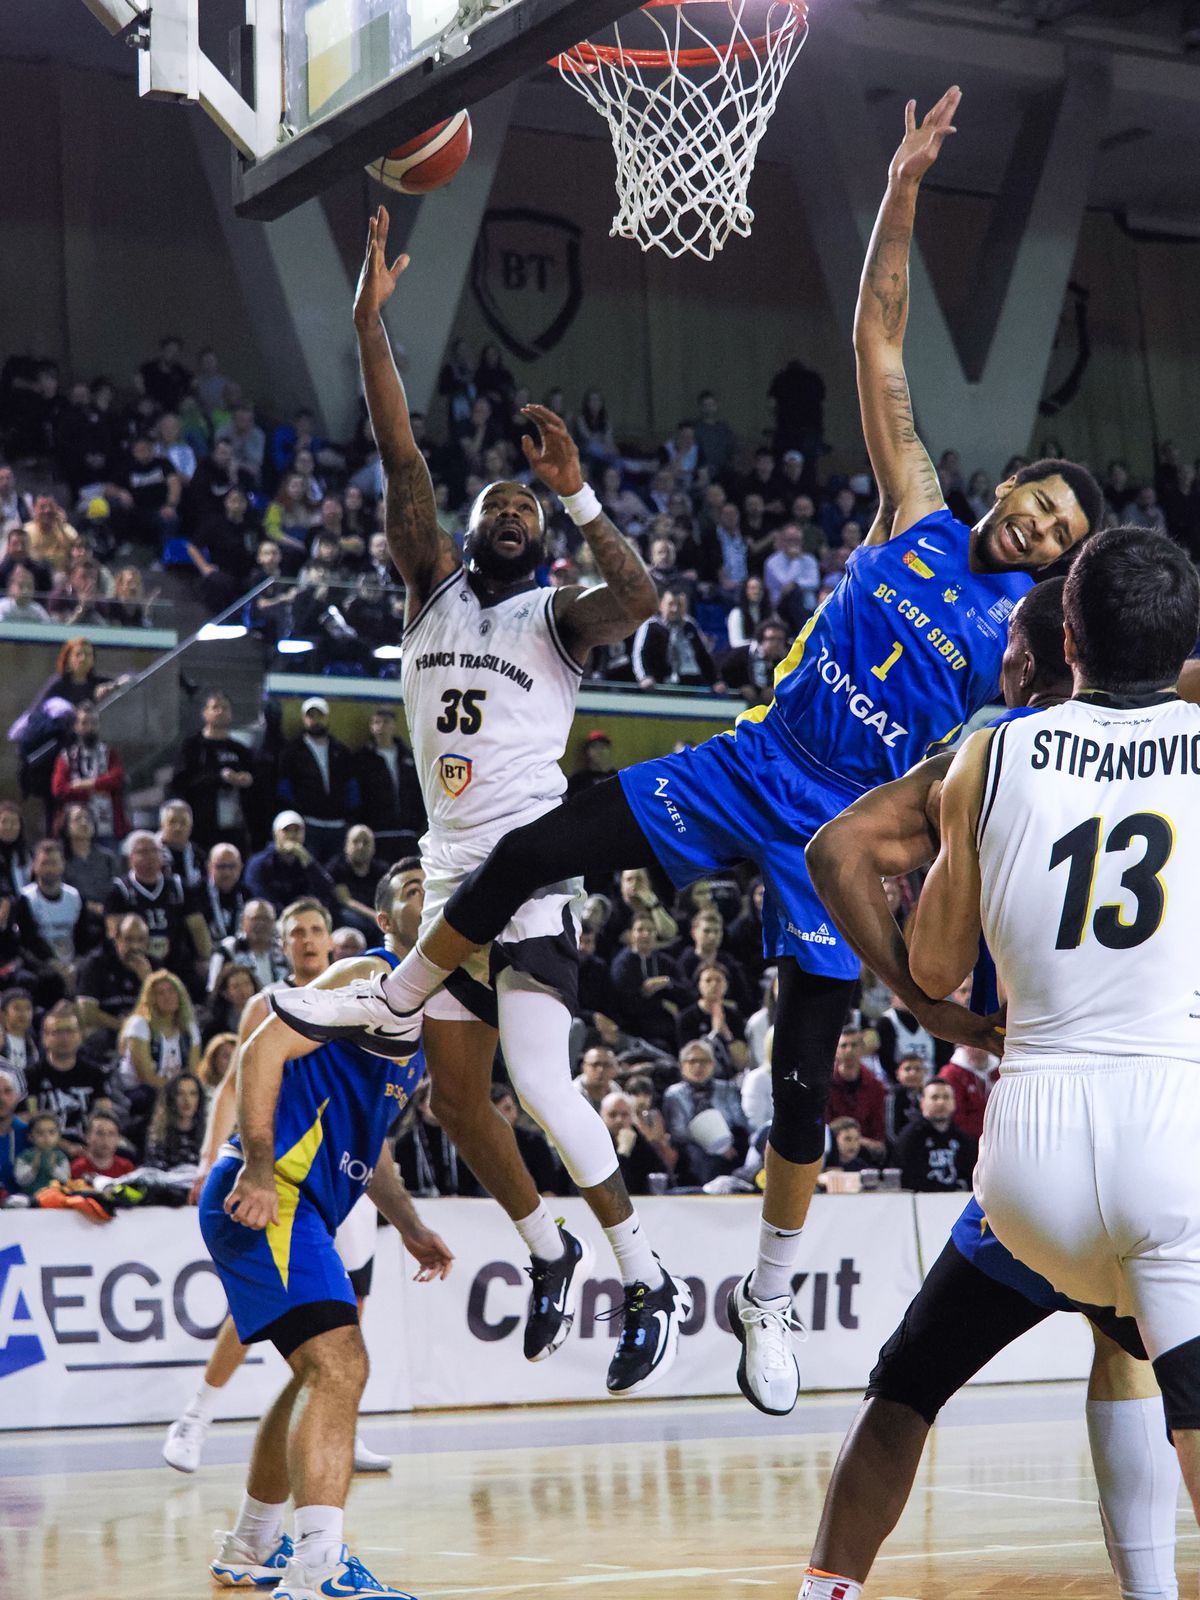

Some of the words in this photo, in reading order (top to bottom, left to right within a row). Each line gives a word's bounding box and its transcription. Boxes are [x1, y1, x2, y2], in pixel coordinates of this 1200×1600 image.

[503, 251, 555, 292] BT
[873, 583, 897, 603] BC
[898, 598, 931, 628] CSU
[926, 627, 967, 671] SIBIU
[870, 641, 904, 682] 1
[436, 688, 487, 735] 35
[444, 764, 466, 780] BT
[663, 800, 687, 833] AZETS
[1048, 811, 1177, 950] 13
